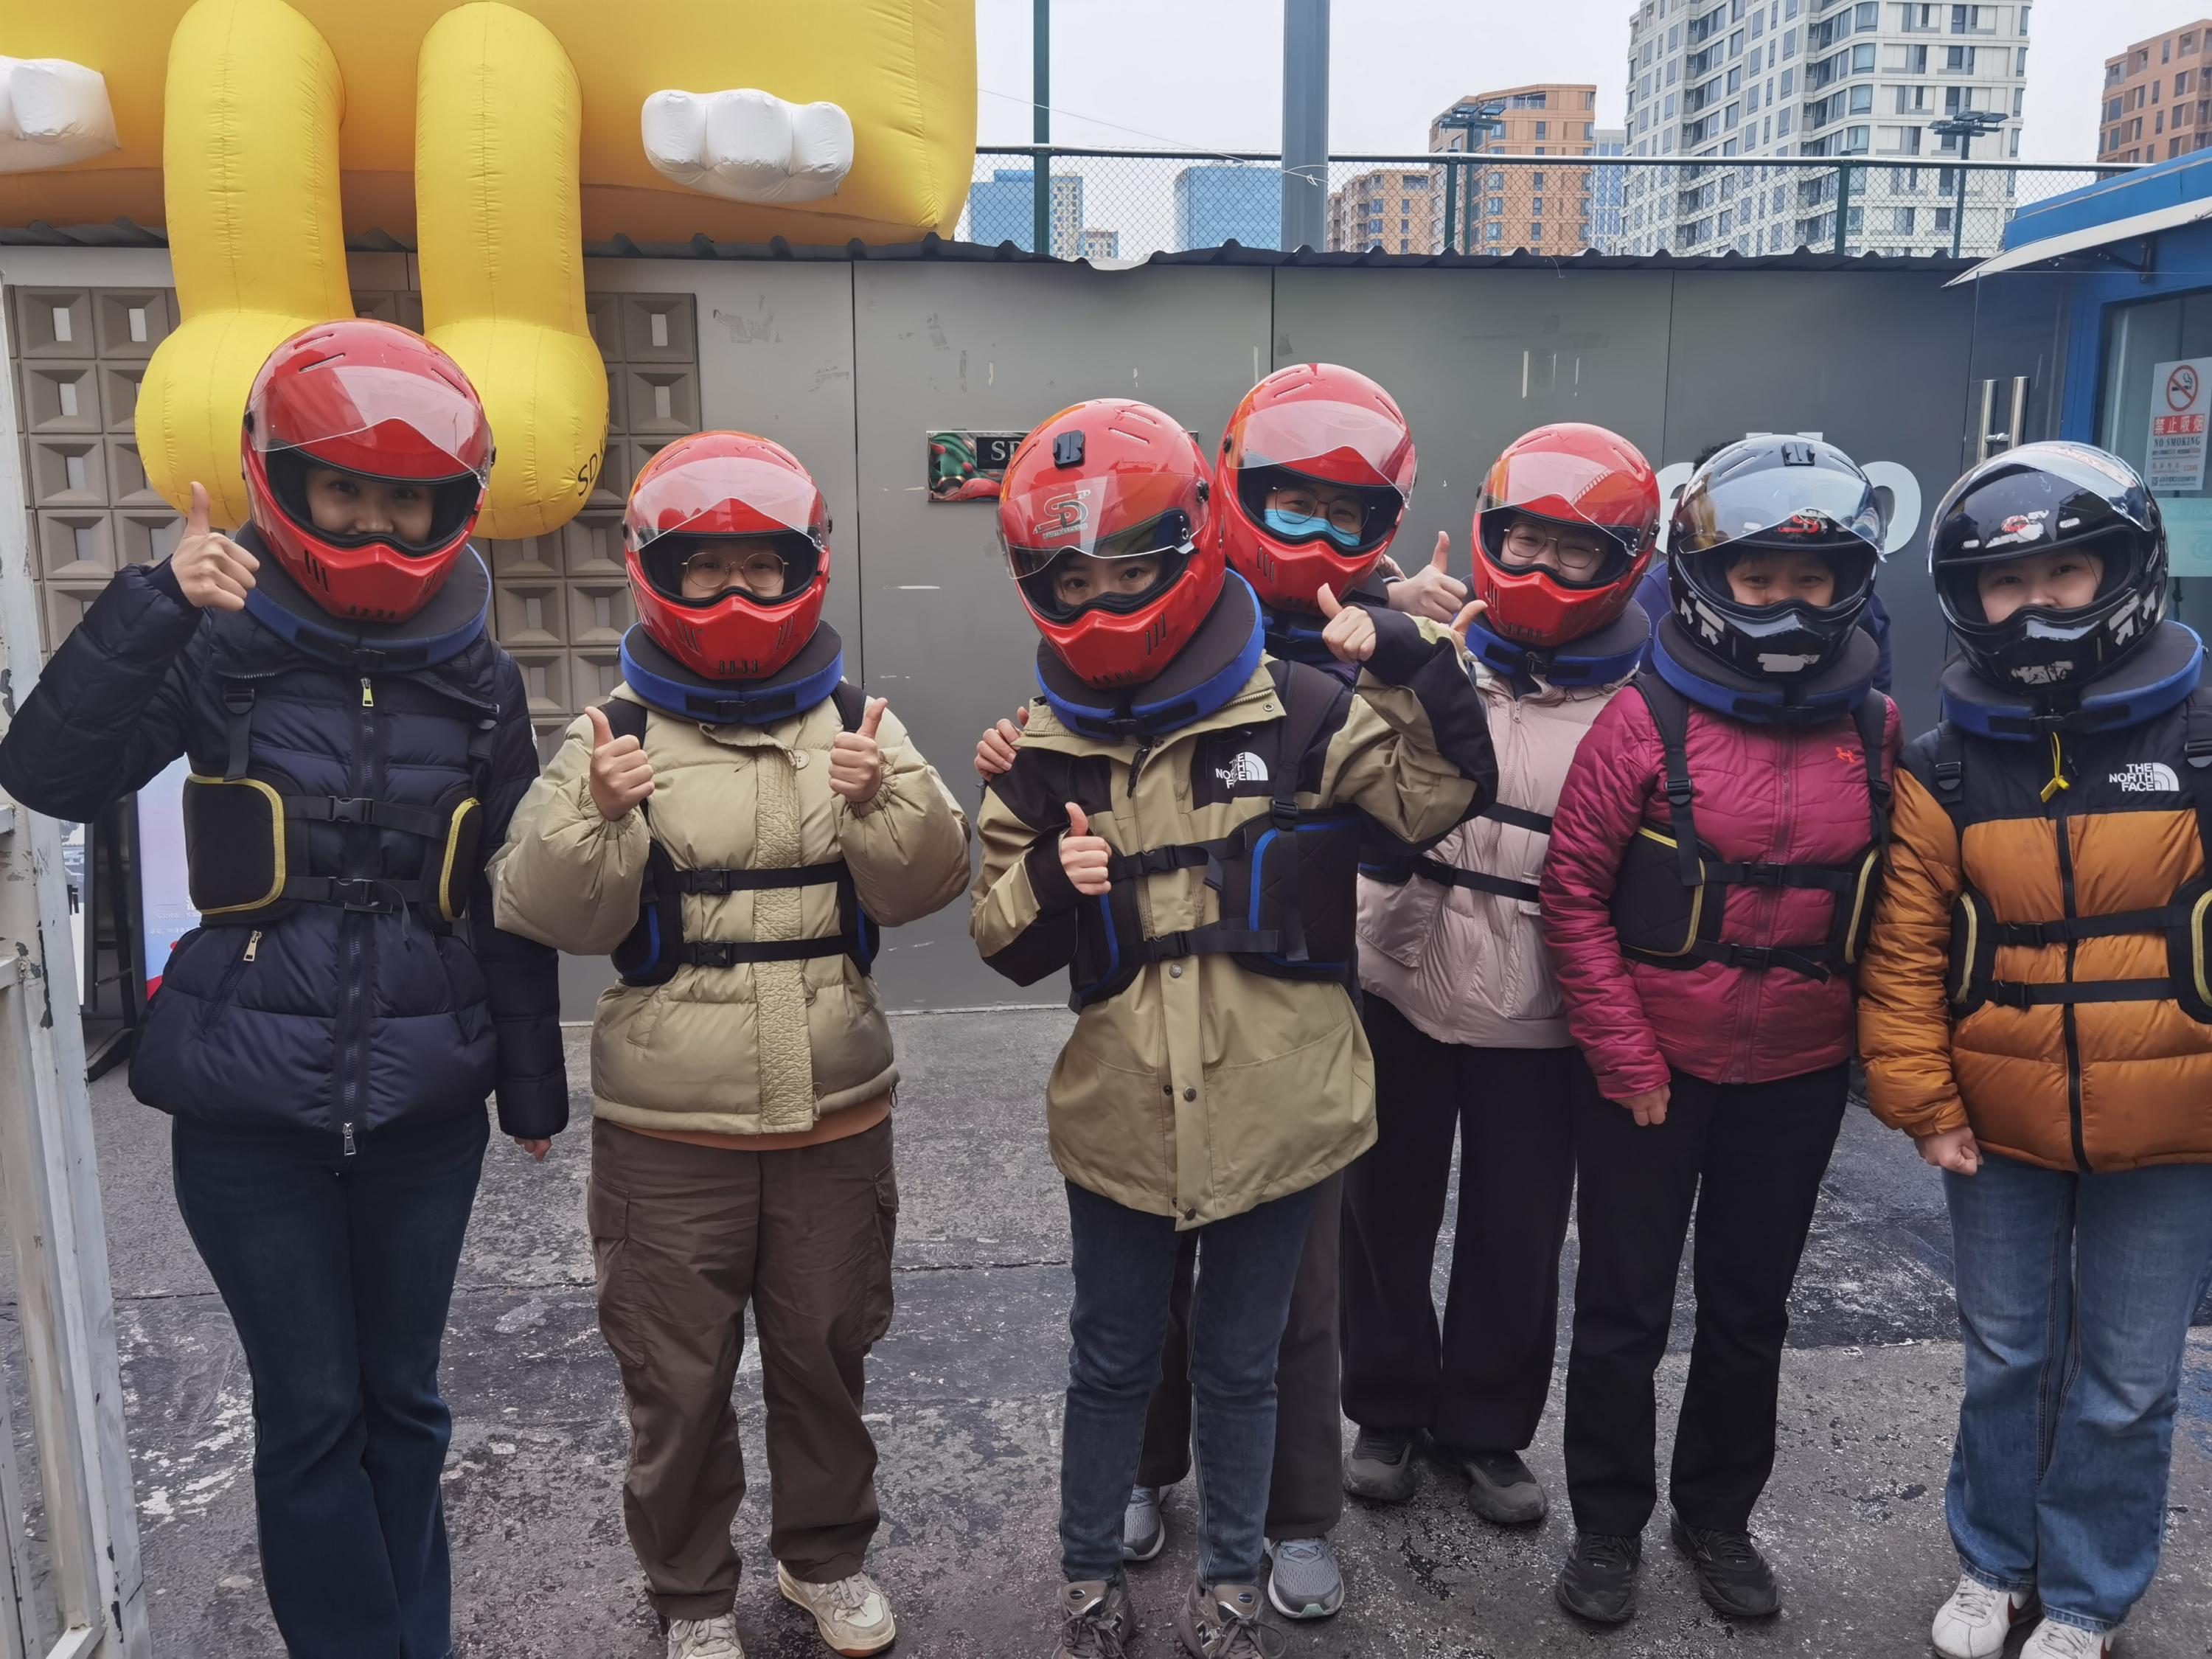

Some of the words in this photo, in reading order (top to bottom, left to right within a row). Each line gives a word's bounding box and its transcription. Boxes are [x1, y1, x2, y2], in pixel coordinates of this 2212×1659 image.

[2154, 415, 2204, 435] 禁止吸烟
[2154, 438, 2164, 448] NO
[2166, 436, 2200, 447] SMOKING
[2126, 762, 2152, 774] THE
[2109, 772, 2154, 783] NORTH
[2121, 782, 2154, 792] FACE
